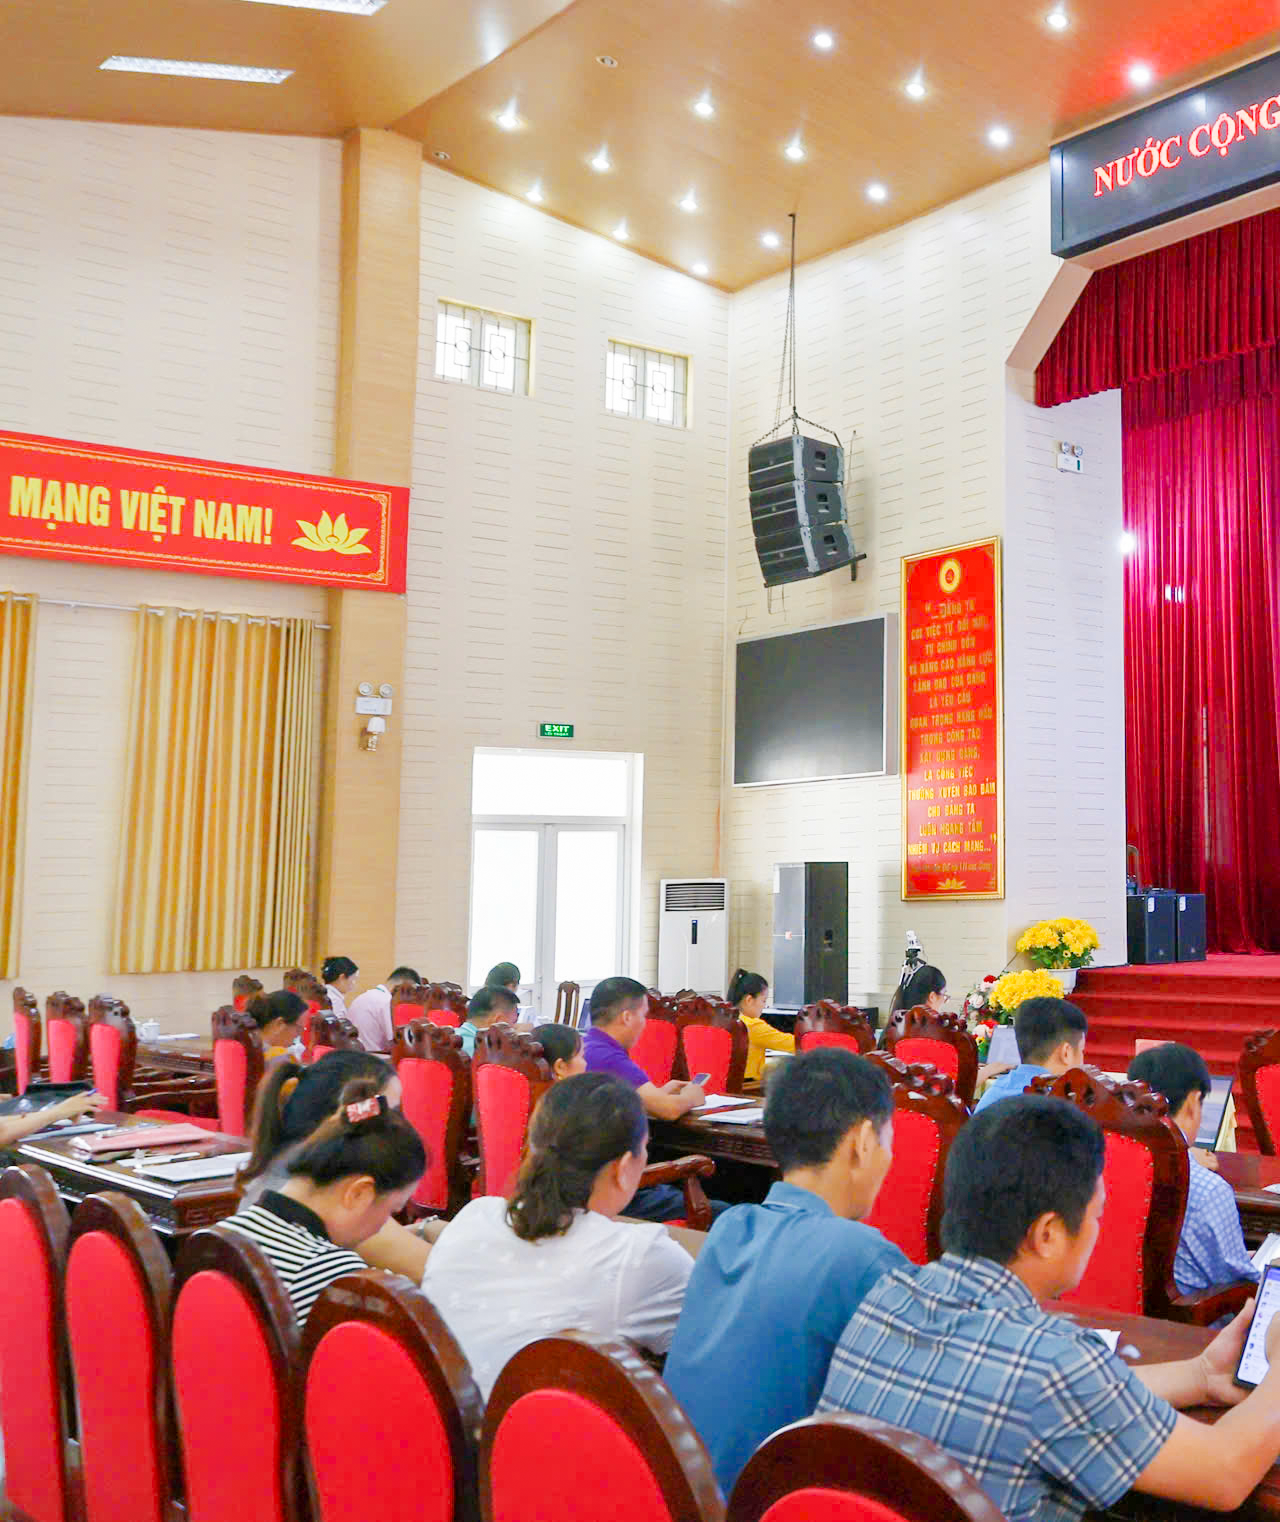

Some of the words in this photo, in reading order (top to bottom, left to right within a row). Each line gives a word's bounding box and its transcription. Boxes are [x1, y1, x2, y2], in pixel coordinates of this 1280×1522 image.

[1093, 137, 1182, 197] NƯỚC
[10, 475, 111, 530] MẠNG
[119, 486, 186, 542] VIỆT
[193, 499, 274, 545] NAM!
